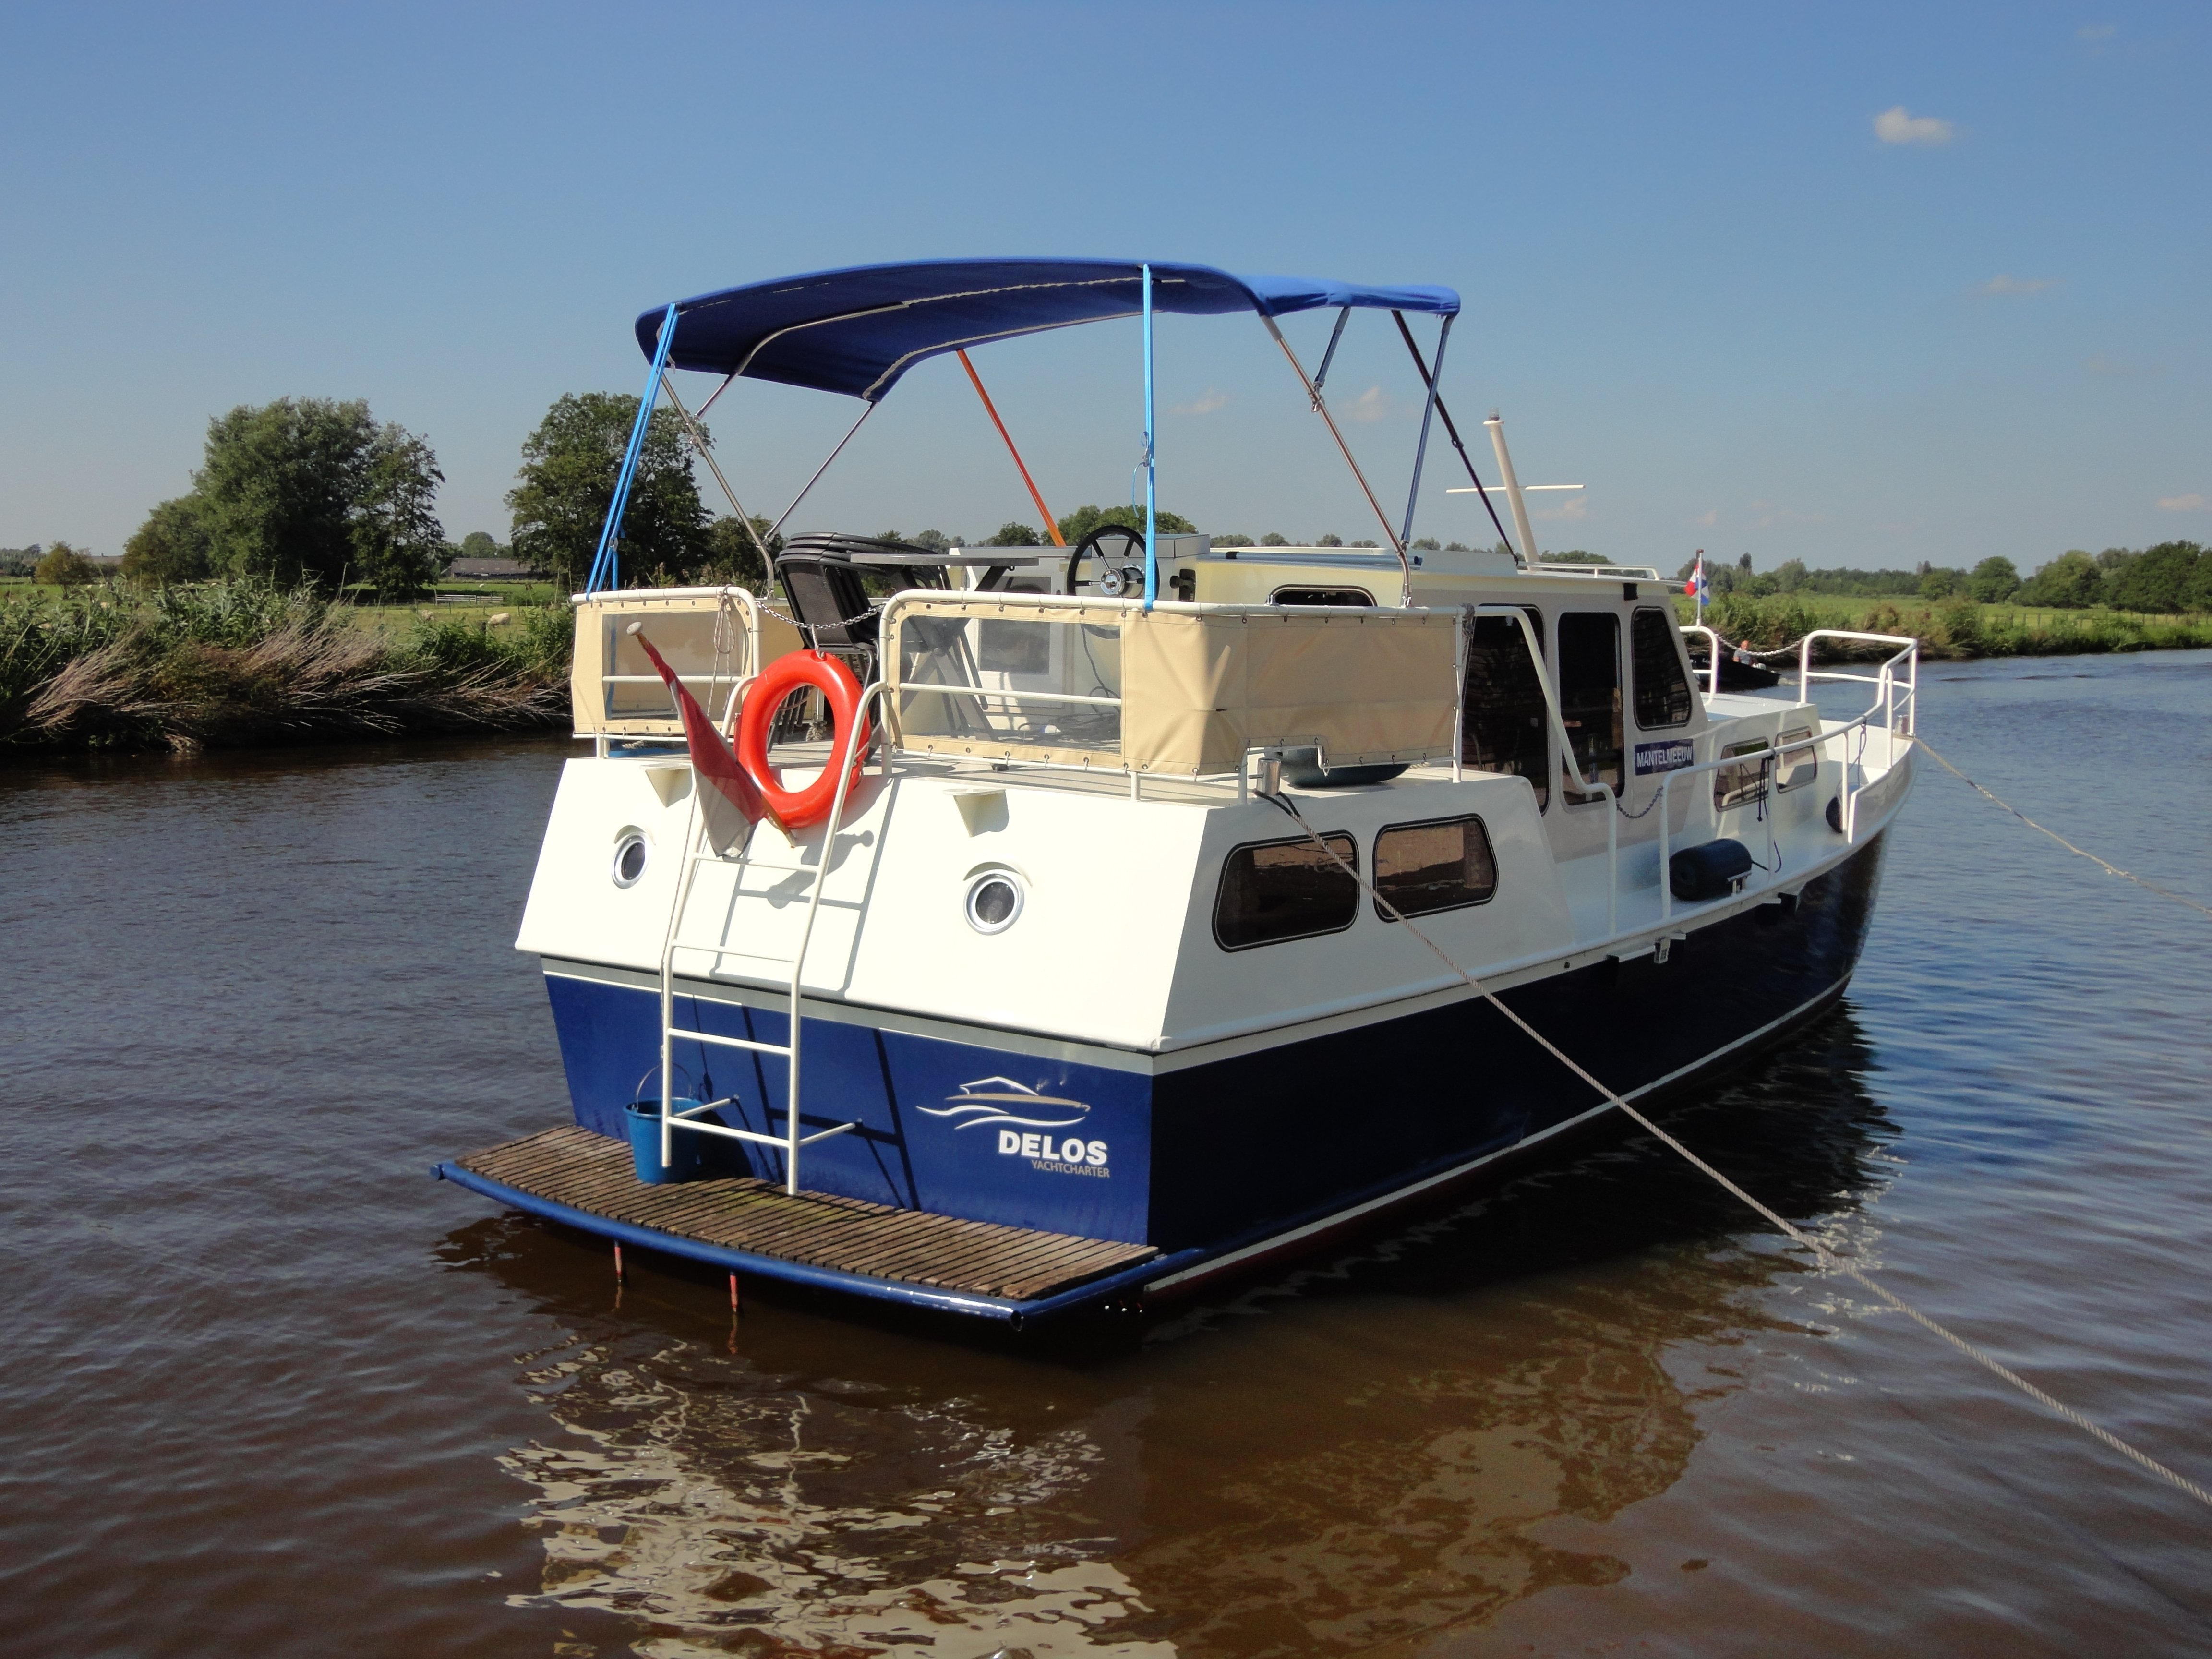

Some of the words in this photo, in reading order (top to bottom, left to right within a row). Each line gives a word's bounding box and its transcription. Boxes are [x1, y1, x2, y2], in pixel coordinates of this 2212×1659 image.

[1637, 746, 1693, 768] MANTELMEEUW
[998, 1130, 1107, 1166] DELOS
[1031, 1159, 1110, 1178] YACHTCHARTER
